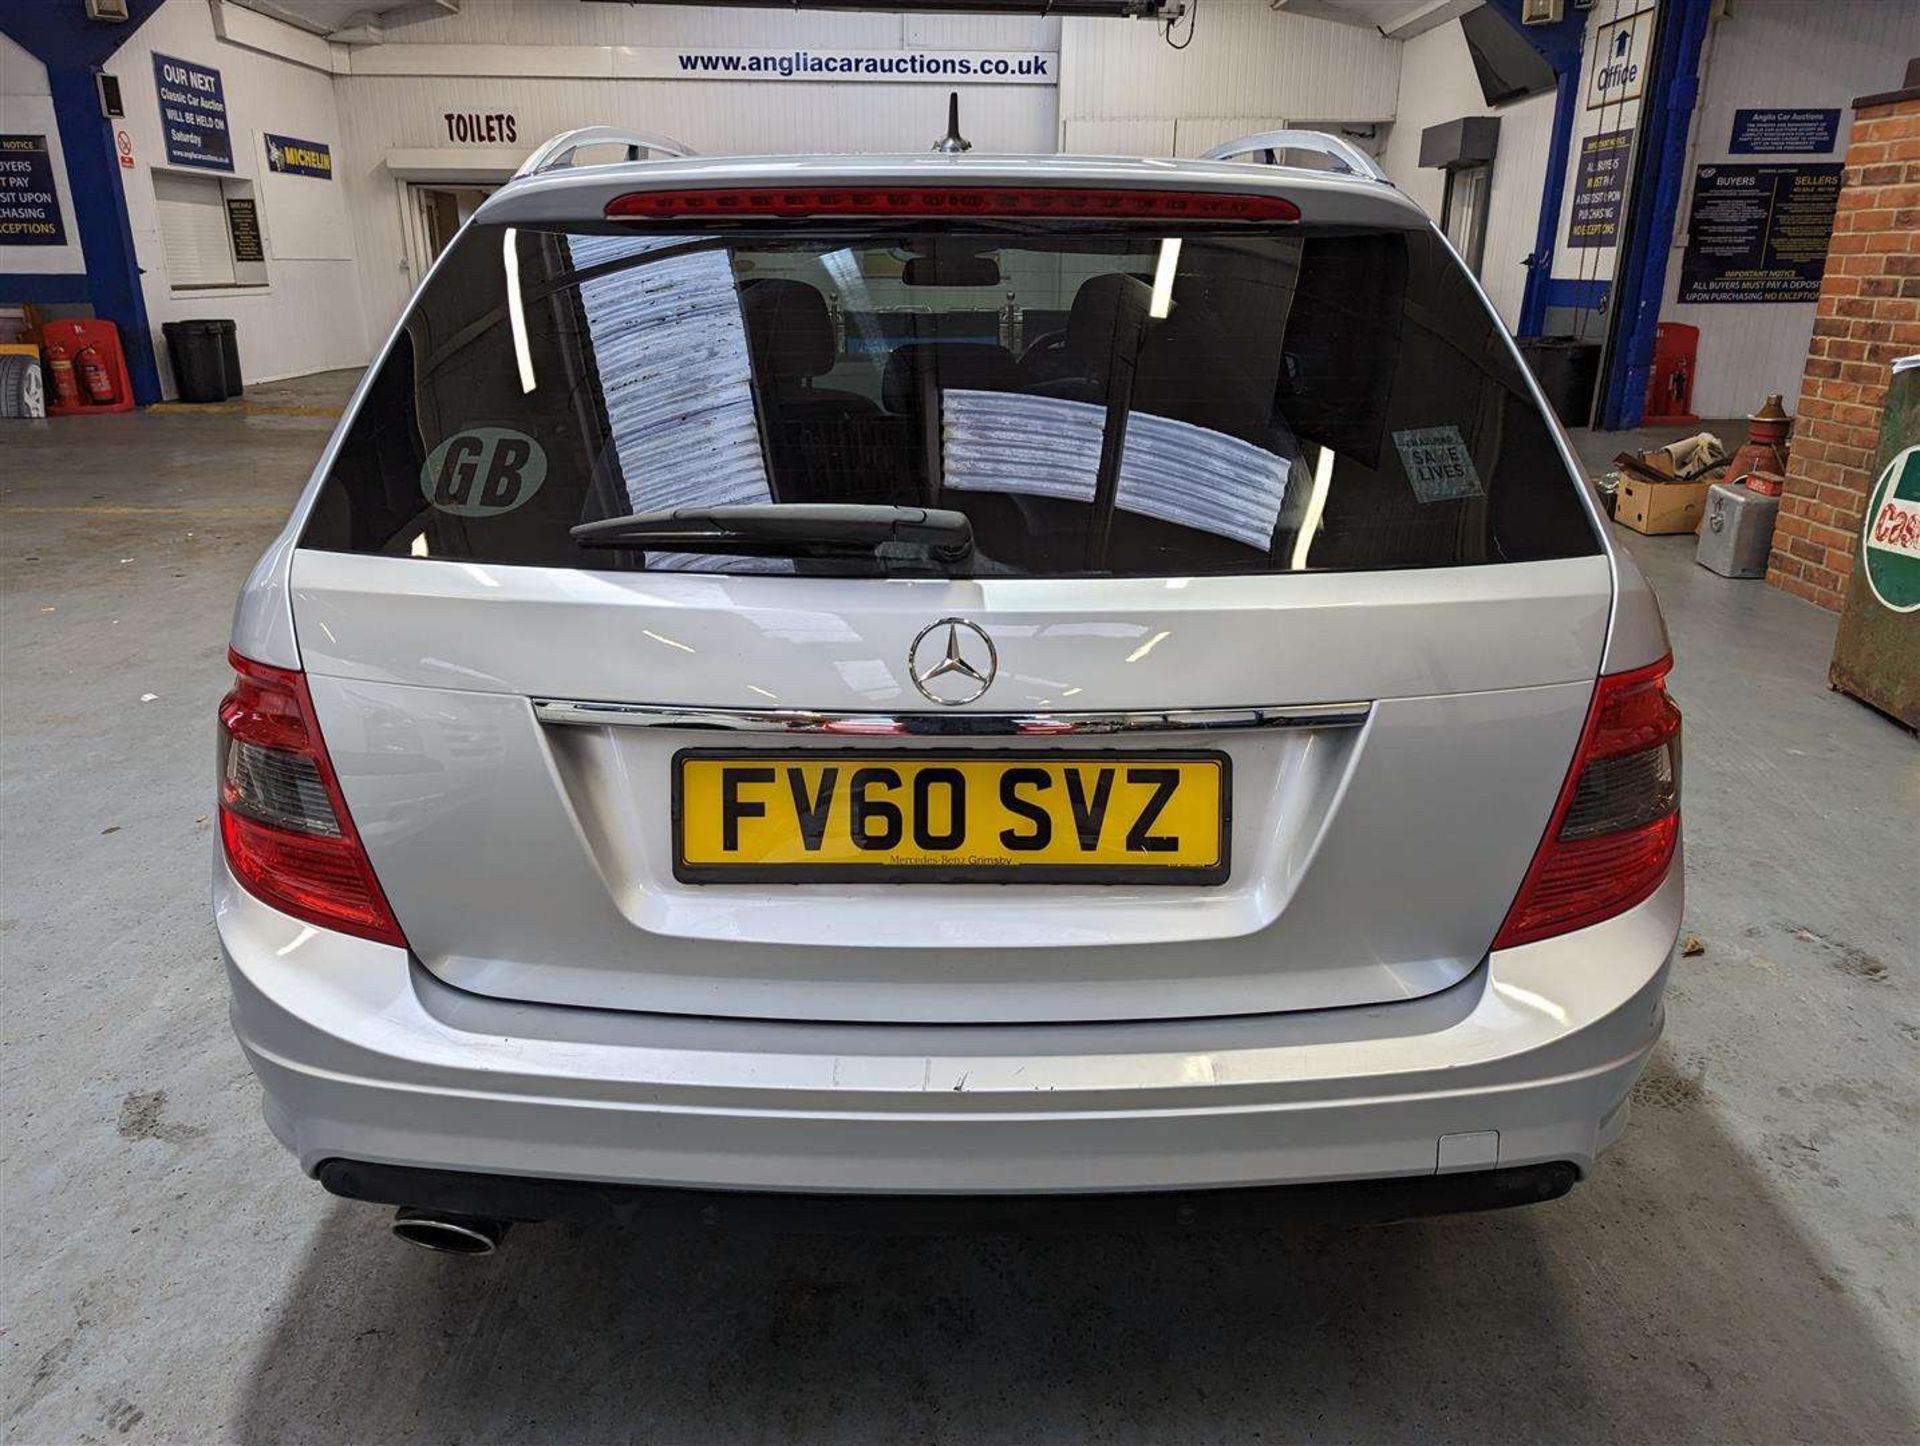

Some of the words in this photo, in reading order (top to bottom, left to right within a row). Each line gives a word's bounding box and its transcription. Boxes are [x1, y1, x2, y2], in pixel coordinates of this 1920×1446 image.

[678, 52, 1048, 76] www.angliacarauctions.co.uk
[164, 64, 188, 86] OUR
[189, 71, 216, 93] NEXT
[1597, 63, 1637, 91] Office
[165, 108, 185, 122] WILL
[185, 113, 195, 125] BE
[444, 113, 517, 144] TOILETS
[3, 141, 33, 150] NOTICE
[284, 146, 331, 170] MICHELIN
[9, 177, 29, 187] PAY
[1716, 177, 1756, 186] BUYERS
[1794, 176, 1839, 185] SELLERS
[19, 192, 52, 203] UPON
[1769, 270, 1796, 278] NOTICE
[1693, 282, 1708, 290] ALL
[1709, 281, 1740, 290] BUYERS
[1741, 281, 1765, 290] MUST
[1766, 281, 1782, 290] PAY
[1783, 281, 1789, 289] A
[1686, 293, 1710, 301] UPON
[1711, 293, 1763, 301] PURCHASING
[1764, 292, 1777, 300] NO
[1413, 447, 1460, 465] SAE
[435, 436, 531, 507] GB
[1419, 464, 1464, 481] LIVES
[722, 768, 966, 851] FV60
[999, 768, 1180, 852] SVZ
[890, 855, 965, 865] Mercedes-Benz
[968, 855, 1012, 866] Grimsby
